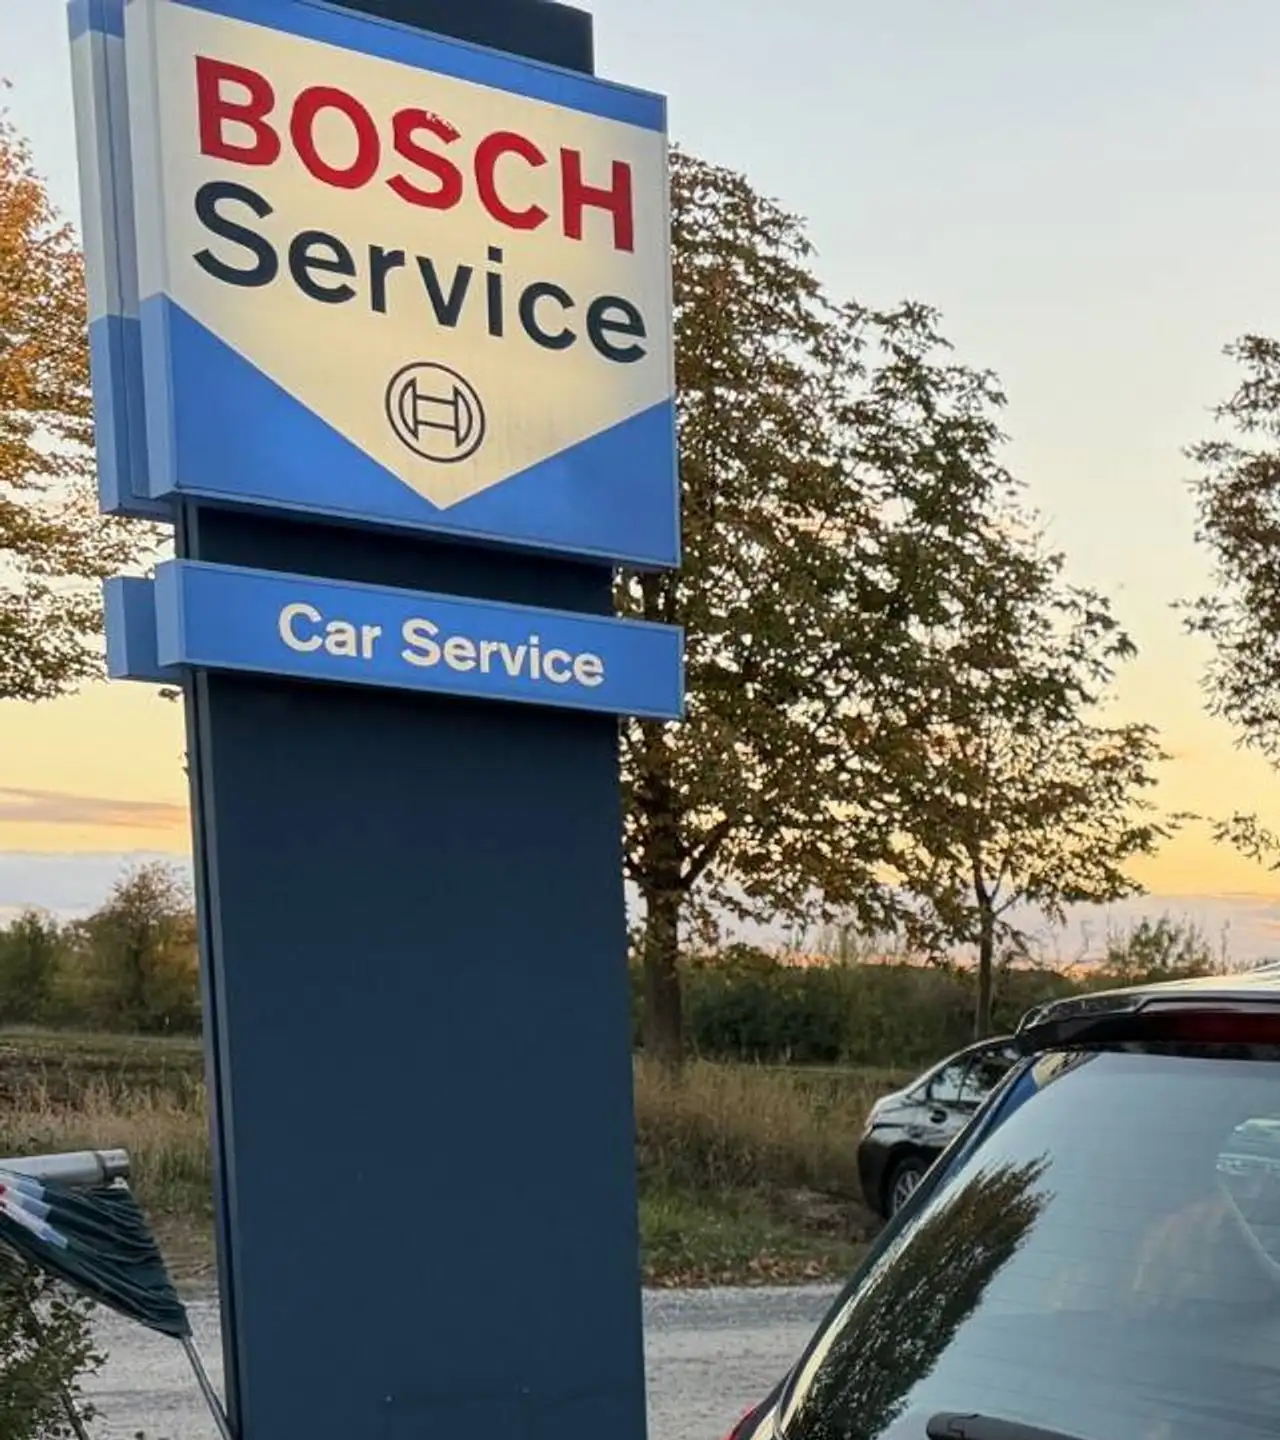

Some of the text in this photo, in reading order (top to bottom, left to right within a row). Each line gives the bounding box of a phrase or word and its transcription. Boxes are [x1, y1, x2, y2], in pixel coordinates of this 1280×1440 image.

[195, 56, 635, 253] BOSCH
[193, 180, 647, 363] Service
[278, 603, 604, 687] Car Service
